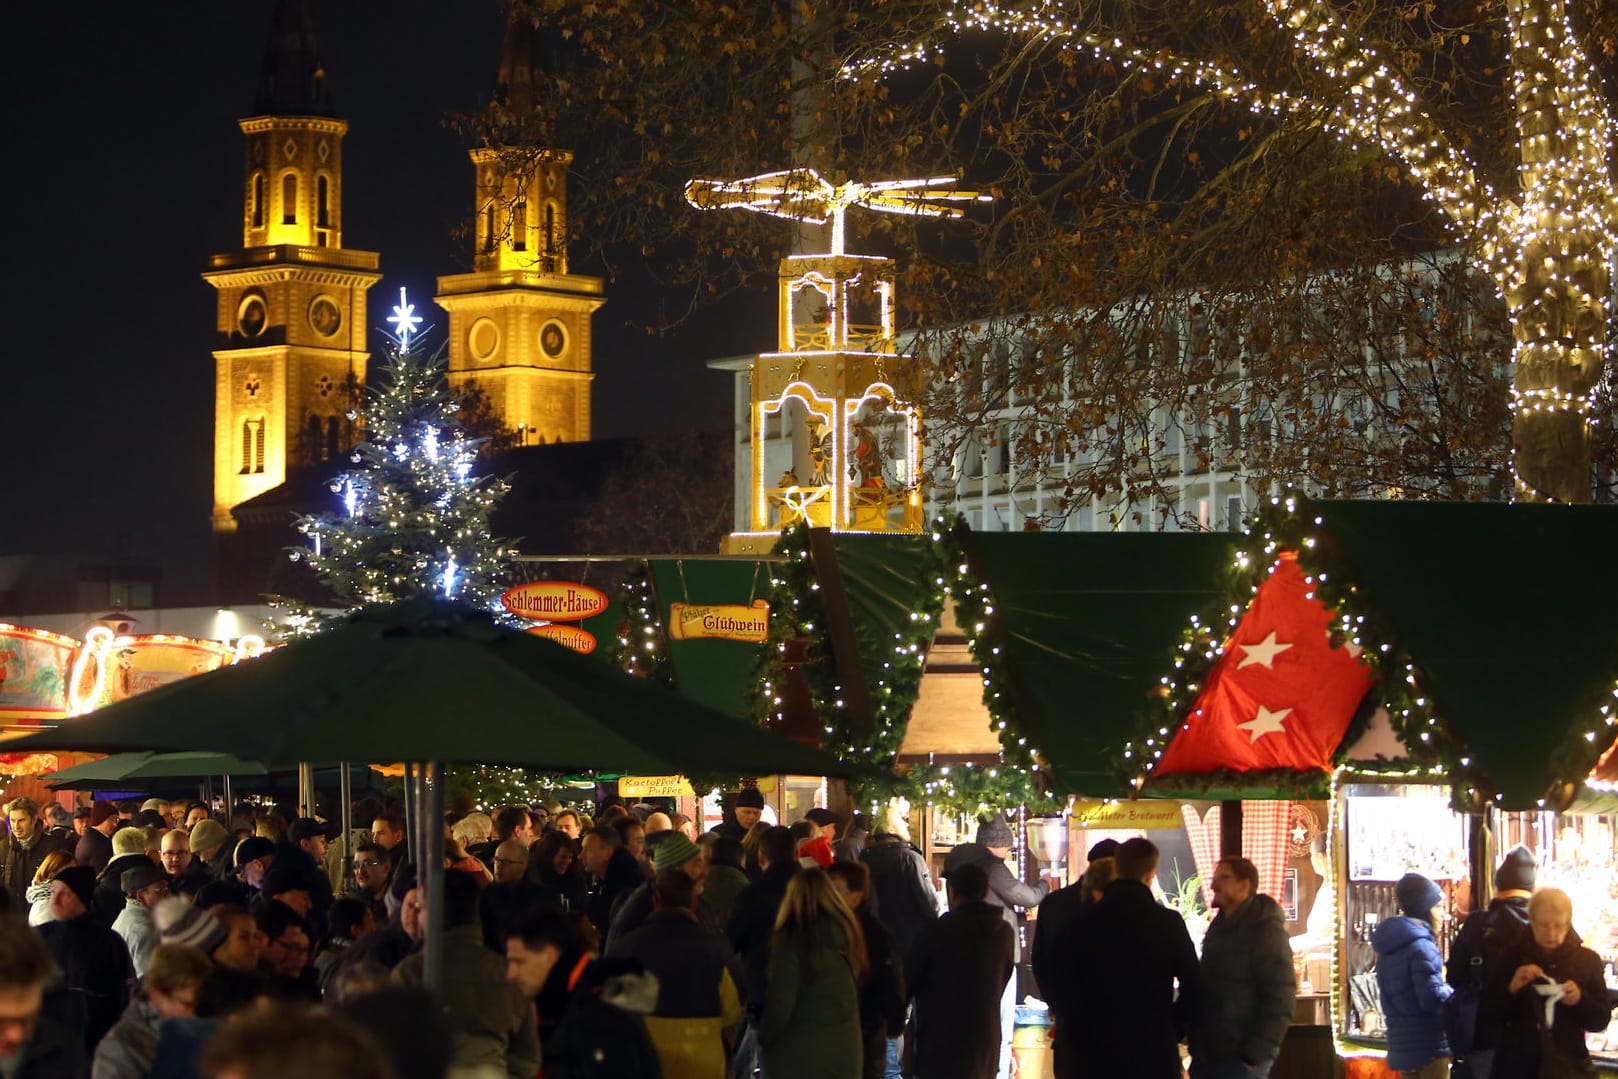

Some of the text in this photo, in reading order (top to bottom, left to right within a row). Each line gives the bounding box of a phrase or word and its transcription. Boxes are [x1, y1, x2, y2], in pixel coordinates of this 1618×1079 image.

[505, 588, 603, 612] Schlemmer-Häusel
[703, 615, 765, 632] Glühwein
[648, 786, 683, 795] Puffer
